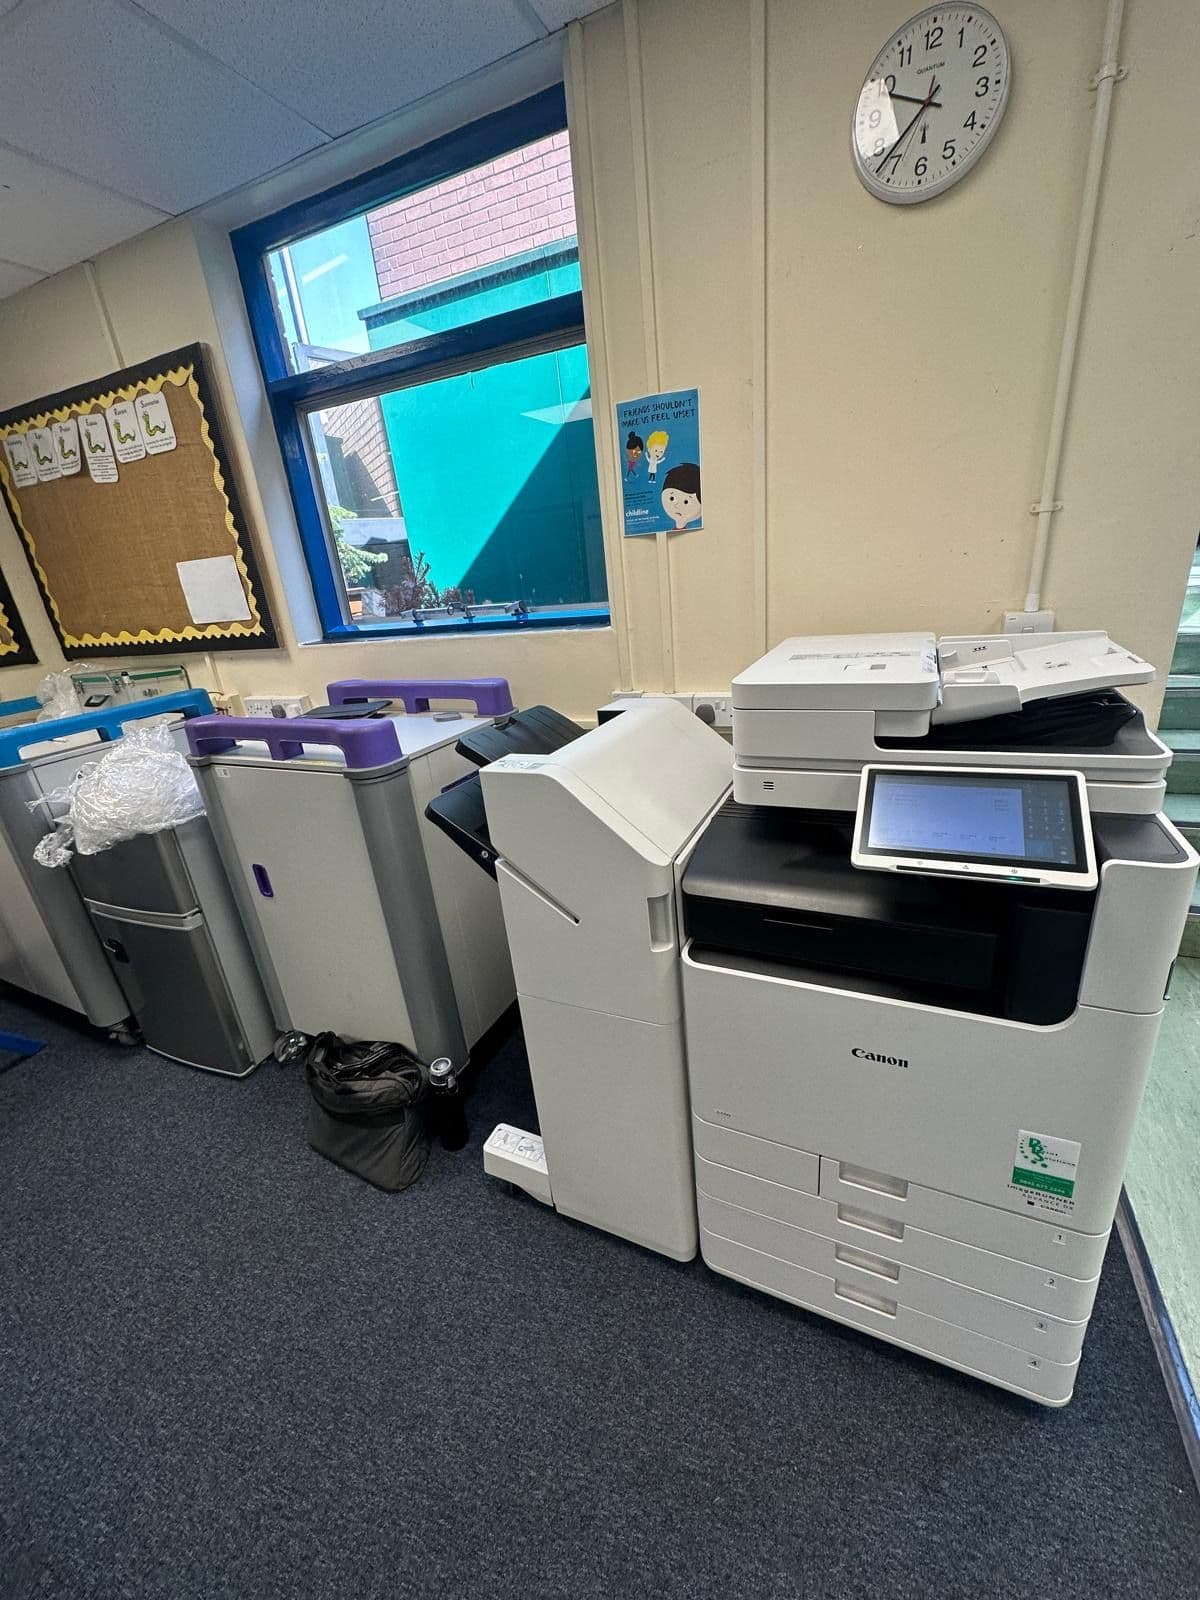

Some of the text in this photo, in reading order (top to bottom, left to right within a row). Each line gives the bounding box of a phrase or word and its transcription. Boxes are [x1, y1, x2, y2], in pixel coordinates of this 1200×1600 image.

[924, 27, 943, 50] 12
[958, 28, 964, 48] 1
[899, 45, 912, 67] 11
[972, 45, 987, 68] 2
[916, 62, 945, 74] QUANTUM
[975, 76, 989, 97] 3
[869, 110, 881, 128] 9
[963, 110, 977, 130] 4
[943, 139, 956, 159] 5
[889, 154, 902, 175] 7
[914, 157, 927, 176] 6
[622, 408, 696, 428] MAKE US FEEL UPSET
[623, 399, 692, 417] FRIENDS SHOULDN'T
[625, 508, 649, 517] childline
[851, 1047, 909, 1069] Canon
